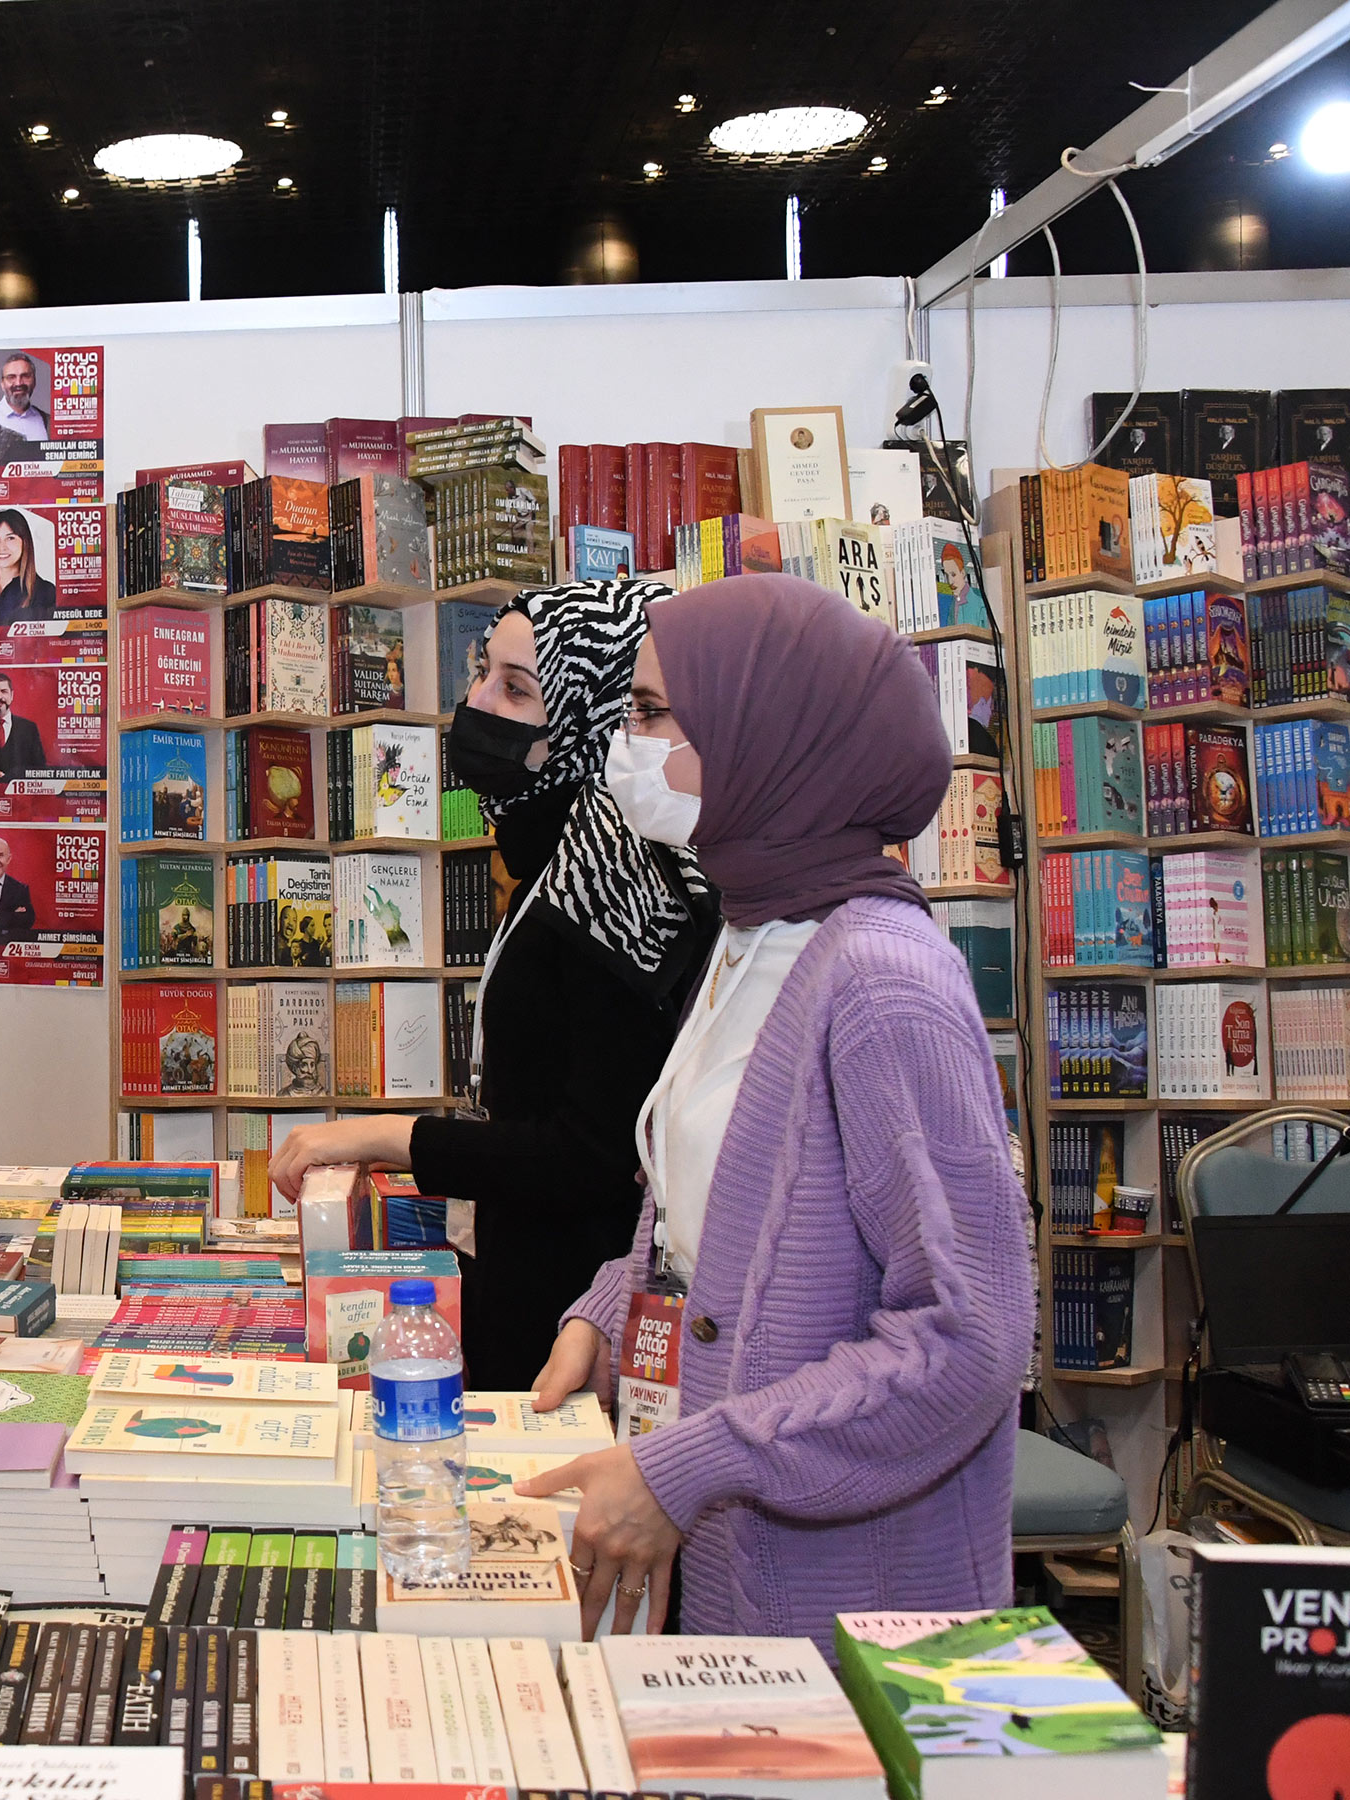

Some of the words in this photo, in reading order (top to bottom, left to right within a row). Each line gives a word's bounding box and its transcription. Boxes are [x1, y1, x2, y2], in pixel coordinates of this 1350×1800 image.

[55, 352, 98, 370] konya
[55, 363, 97, 380] kitap
[55, 377, 97, 390] günleri
[54, 397, 79, 410] 15-24
[40, 441, 75, 451] NURULLAH
[77, 441, 97, 452] GENÇ
[349, 442, 392, 450] MUHAMMED
[45, 451, 65, 460] SENAİ
[65, 450, 97, 460] DEMİRCİ
[290, 456, 317, 464] HAYATI
[357, 452, 382, 460] HAYATI
[8, 464, 22, 477] 20
[24, 462, 40, 470] EKİM
[79, 462, 97, 470] 20:00
[791, 462, 819, 470] AHMED
[169, 470, 212, 480] MUHAMMED
[284, 500, 318, 516] Duanın
[58, 510, 101, 527] konya
[170, 511, 217, 524] MÜSLÜMANIN
[290, 512, 313, 526] Ruhu
[59, 522, 100, 538] kitap
[170, 521, 200, 532] TAKVİMİ
[59, 535, 101, 548] günleri
[496, 543, 528, 553] NURULLAH
[586, 548, 615, 567] KAYI
[839, 538, 878, 570] ARA
[59, 556, 82, 569] 15-24
[497, 558, 513, 568] GENÇ
[53, 609, 83, 620] AYŞEGÜL
[84, 608, 103, 618] DEDE
[14, 623, 27, 635] 22
[29, 622, 45, 630] EKİM
[85, 621, 103, 629] 14:00
[1104, 618, 1137, 639] İçimdeki
[154, 626, 205, 643] ENNEAGRAM
[173, 644, 186, 656] İLE
[158, 655, 201, 672] ÖĞRENCİNİ
[58, 670, 101, 688] konya
[164, 673, 196, 687] KEŞFET
[58, 683, 100, 700] kitap
[360, 689, 390, 701] HAREM
[58, 696, 100, 709] günleri
[58, 716, 82, 729] 15-24
[153, 734, 174, 745] EMİR
[176, 734, 202, 748] TİMUR
[25, 769, 54, 779] MEHMET
[55, 769, 75, 779] FATİH
[77, 769, 100, 780] ÇITLAK
[401, 767, 431, 783] Örtüde
[12, 782, 25, 793] 18
[82, 782, 100, 790] 15:00
[56, 834, 99, 852] konya
[56, 847, 98, 864] kitap
[56, 861, 98, 873] günleri
[372, 865, 418, 876] GENÇLERLE
[309, 869, 330, 880] Tarihi
[56, 881, 80, 893] 15-24
[288, 879, 331, 891] Değiştiren
[380, 878, 410, 887] NAMAZ
[279, 889, 331, 901] Konuşmalar
[291, 900, 302, 910] Ali
[37, 933, 60, 942] AHMET
[62, 932, 97, 944] ŞİMŞİRGİL
[8, 944, 22, 956] 24
[24, 943, 40, 951] EKİM
[79, 946, 97, 954] 14:00
[160, 989, 187, 998] BÜYÜK
[189, 989, 213, 999] DOĞUŞ
[280, 999, 325, 1007] BARBAROS
[293, 1017, 314, 1027] PAŞA
[1234, 1016, 1250, 1029] Son
[1226, 1024, 1250, 1039] Turna
[1232, 1041, 1252, 1056] Kuşu
[340, 1300, 377, 1313] kendini
[347, 1310, 370, 1322] affet
[338, 1364, 356, 1377] ADEM
[629, 1384, 668, 1406] YAYINEVİ
[255, 1419, 282, 1441] affet
[290, 1413, 322, 1448] kendini
[853, 1618, 965, 1629] UYUYAN
[981, 1616, 1049, 1626] PERİ
[676, 1653, 759, 1670] TÜRK
[642, 1668, 808, 1688] BİLGELERİ
[121, 1681, 155, 1732] FATİH
[285, 1694, 304, 1726] HİTLER
[393, 1698, 412, 1729] HİTLER
[231, 1703, 253, 1745] BARBAROS
